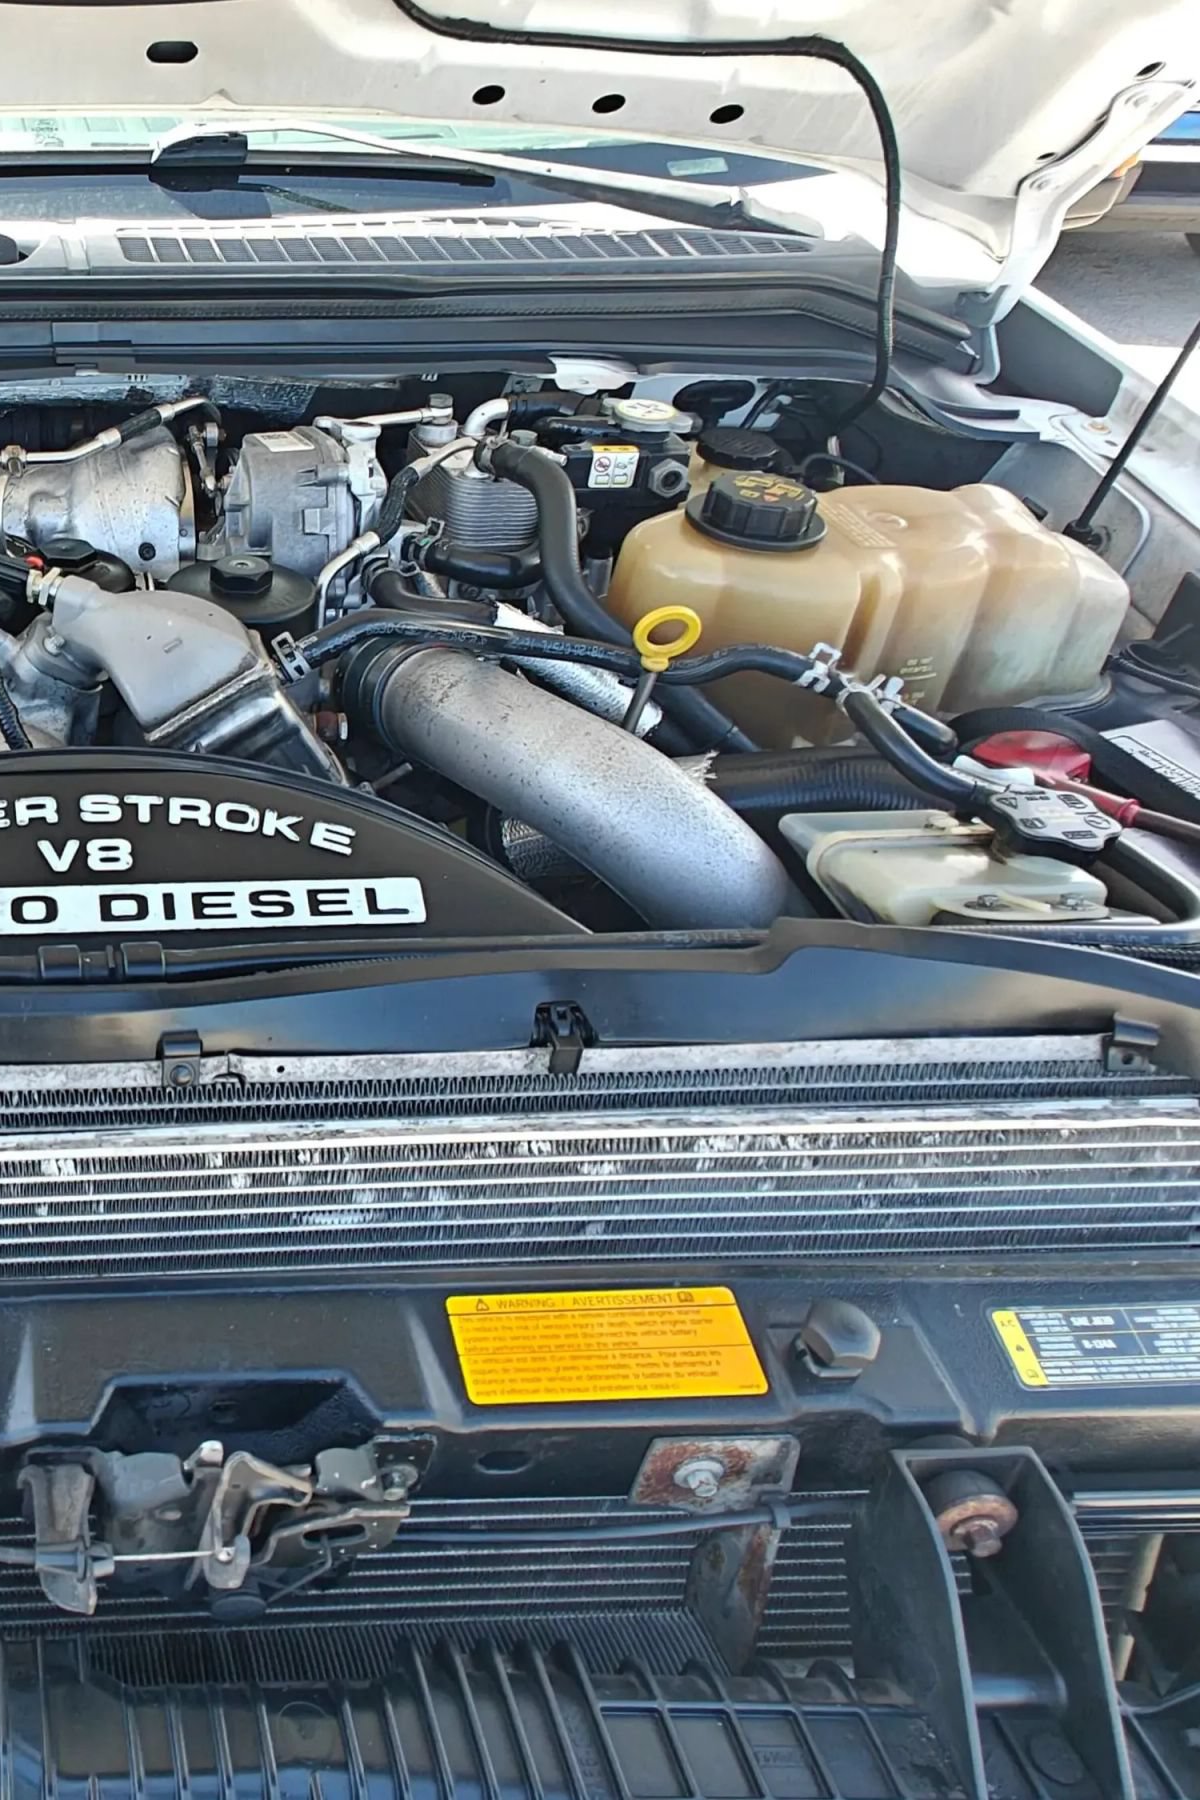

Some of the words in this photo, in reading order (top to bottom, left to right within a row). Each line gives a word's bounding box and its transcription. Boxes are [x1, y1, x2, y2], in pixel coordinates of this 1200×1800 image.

[79, 793, 356, 858] STROKE
[37, 837, 133, 872] V8
[100, 887, 412, 923] DIESEL
[495, 1298, 555, 1310] WARNING
[572, 1293, 673, 1306] AVERTISSEMENT
